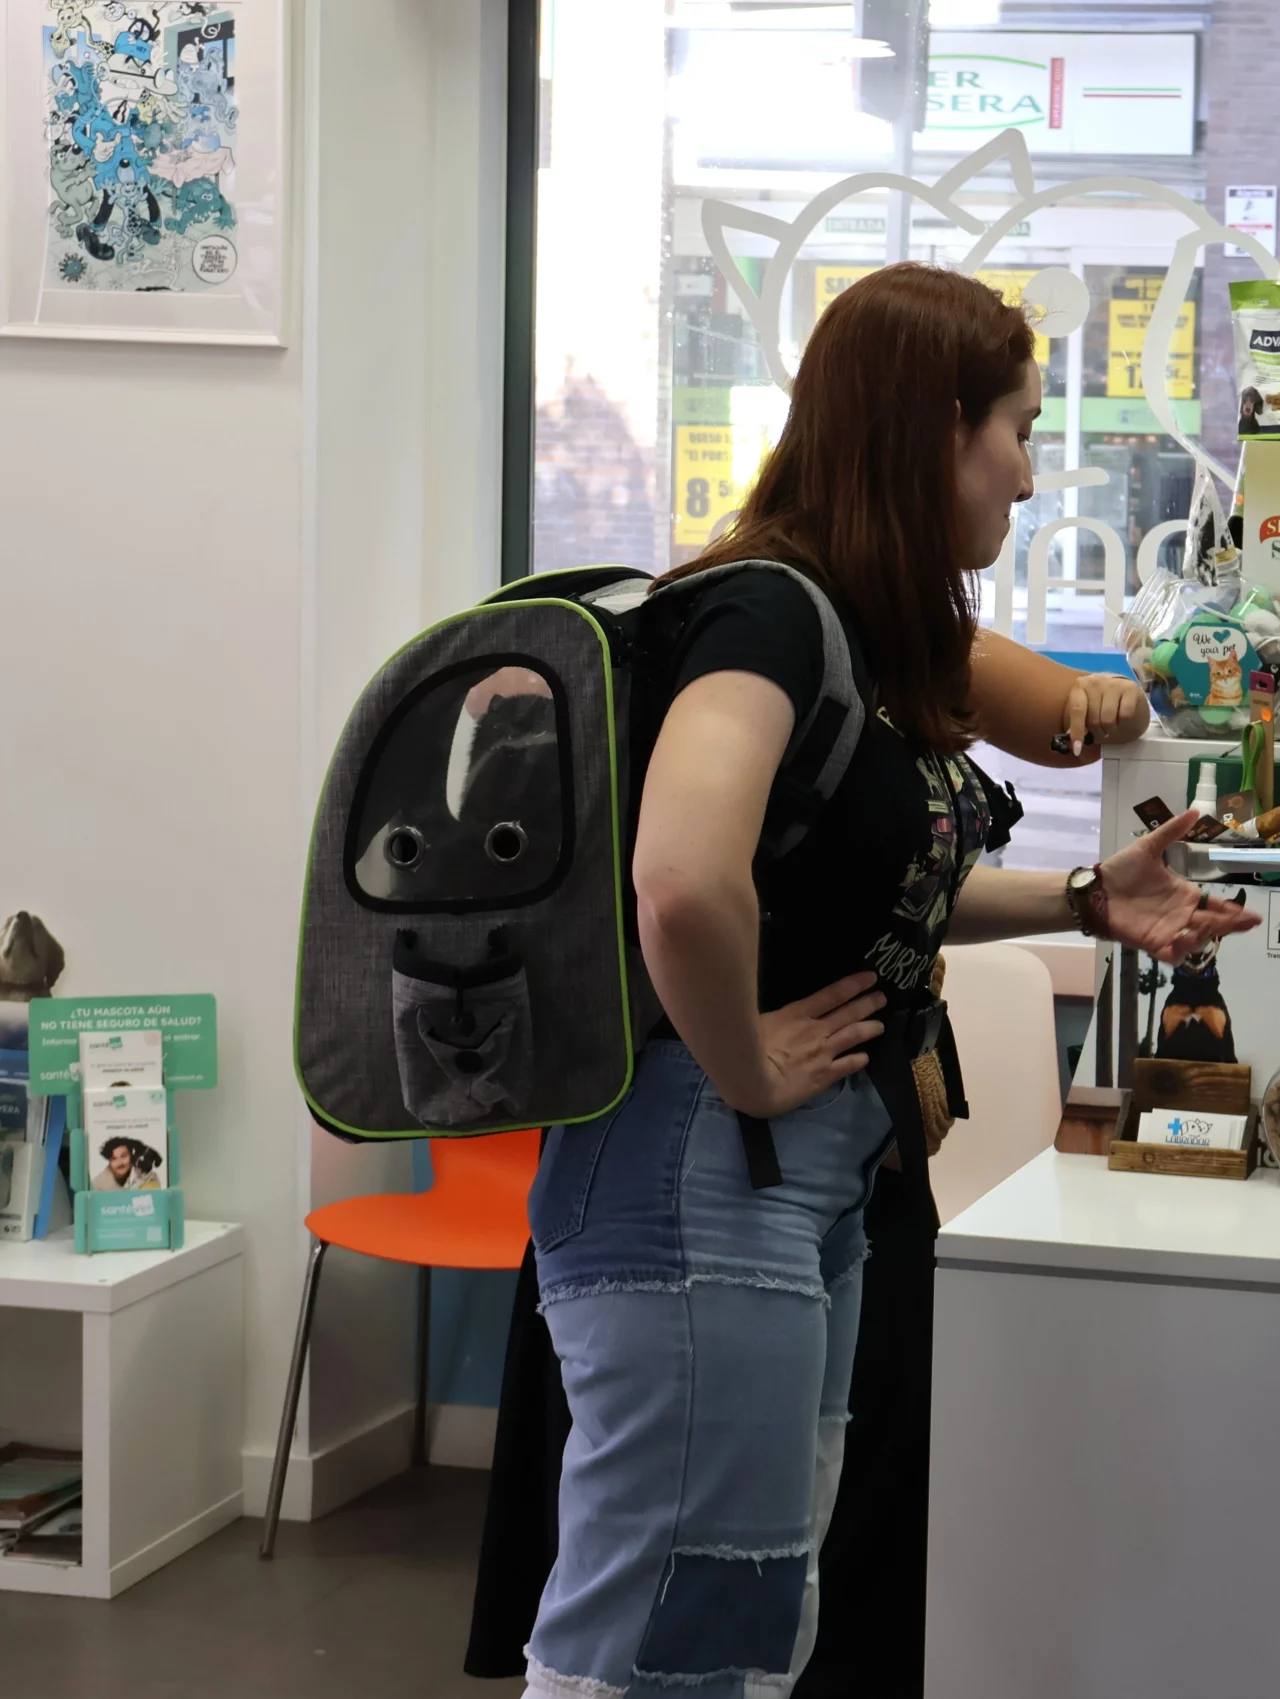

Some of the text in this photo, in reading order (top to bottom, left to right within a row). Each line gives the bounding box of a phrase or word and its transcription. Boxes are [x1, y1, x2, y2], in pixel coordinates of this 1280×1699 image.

[686, 477, 710, 519] 8
[1192, 632, 1211, 645] We
[1200, 643, 1236, 659] your pet
[94, 1006, 144, 1017] MASCOTA
[147, 1005, 171, 1015] AÚN
[41, 1016, 202, 1031] NO TIENE SEGURO DE SALUD?
